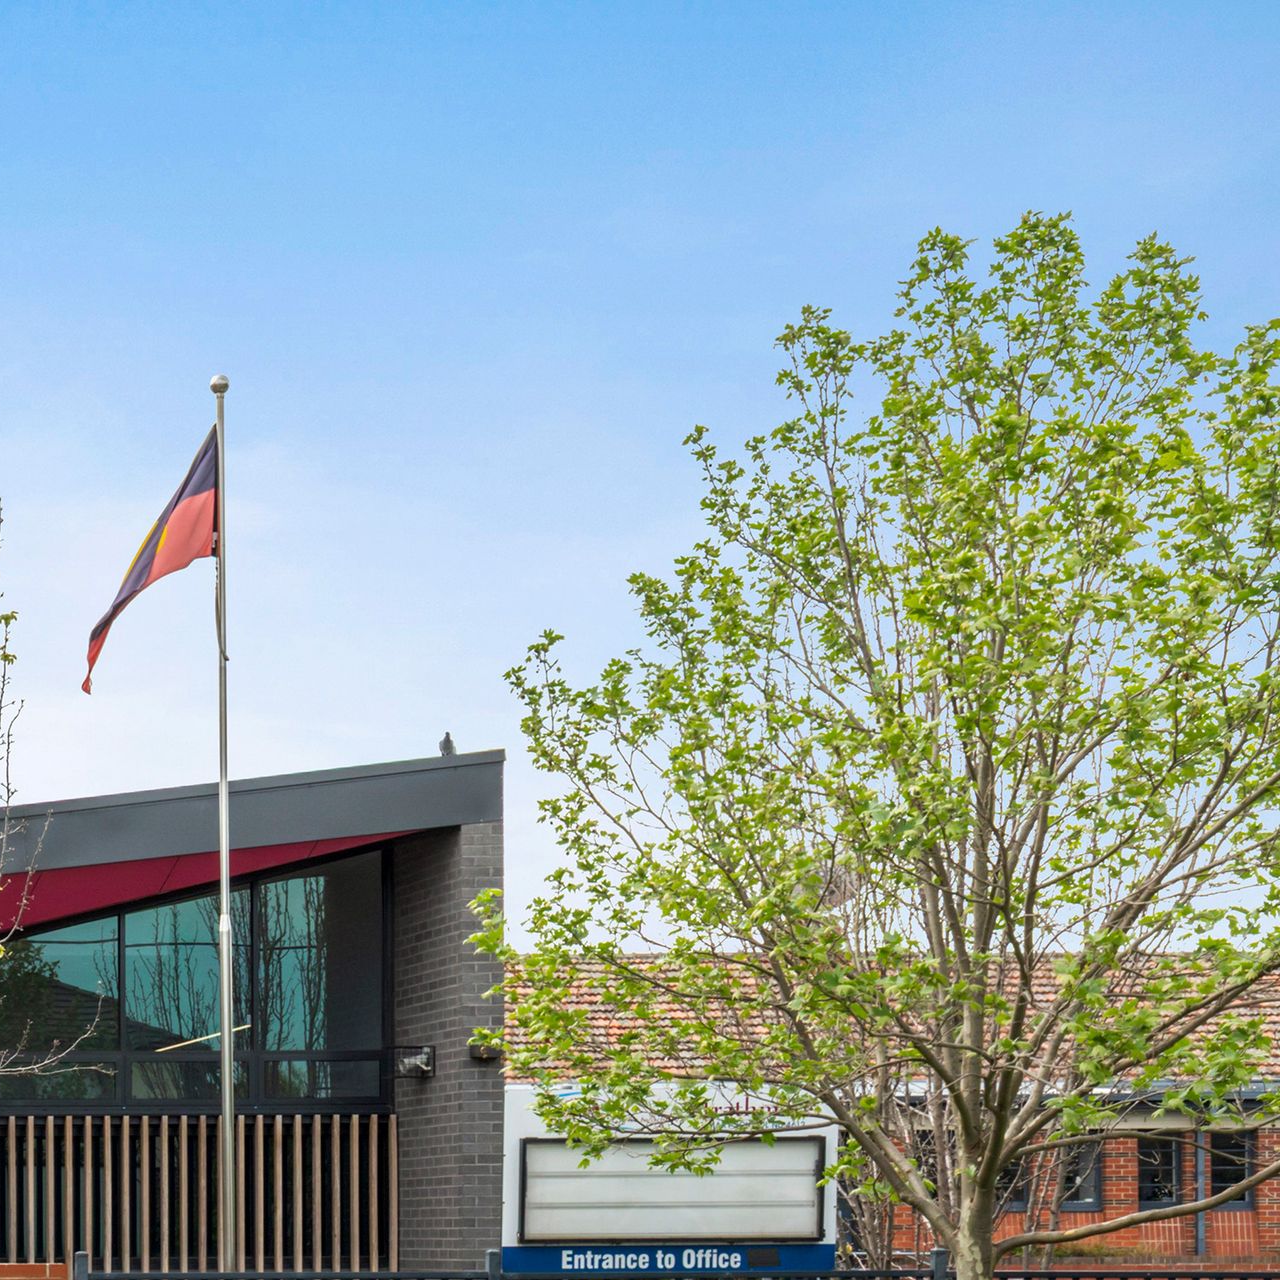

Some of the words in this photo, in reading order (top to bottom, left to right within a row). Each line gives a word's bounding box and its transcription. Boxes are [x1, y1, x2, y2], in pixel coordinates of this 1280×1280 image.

[561, 1249, 650, 1270] Entrance
[656, 1250, 676, 1269] to
[682, 1248, 741, 1268] Office
